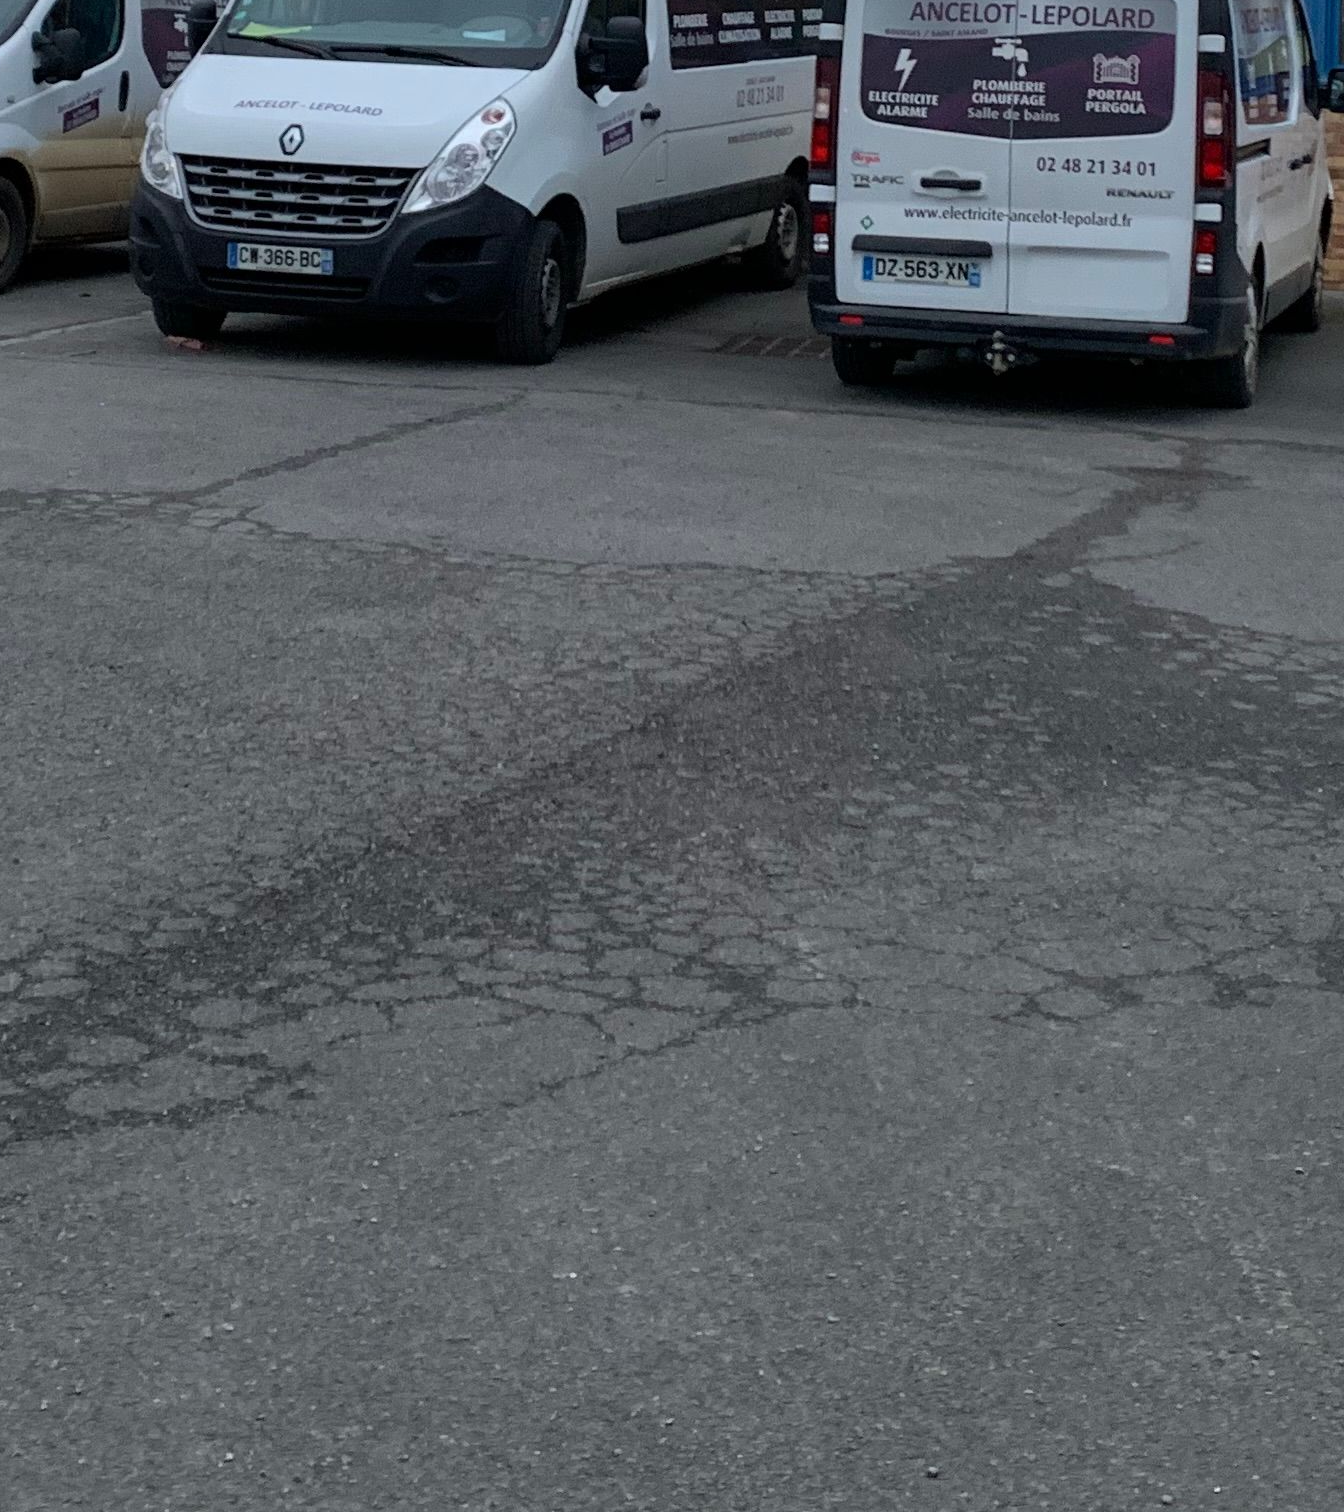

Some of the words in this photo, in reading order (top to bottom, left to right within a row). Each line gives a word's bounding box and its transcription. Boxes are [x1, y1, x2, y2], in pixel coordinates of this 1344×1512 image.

[972, 79, 1046, 94] PLOMBERIE
[868, 90, 939, 106] ELECTRICITE
[971, 92, 1046, 107] CHAUFFAGE
[1087, 87, 1144, 102] PORTAIL
[308, 102, 384, 117] LEPOLARD
[877, 103, 928, 119] ALARME
[967, 106, 1000, 121] Salle
[1002, 107, 1020, 121] de
[1023, 108, 1061, 123] bains
[1085, 100, 1147, 115] PERGOLA
[1036, 156, 1056, 173] 02
[1061, 157, 1082, 174] 48
[1086, 159, 1106, 175] 21
[1111, 160, 1131, 176] 34
[1137, 161, 1157, 177] 01
[851, 172, 905, 186] TRAFIC
[1105, 188, 1176, 200] RENAULT
[904, 206, 1134, 228] www.electricite-ancelot-lepolard.fr
[239, 246, 321, 268] CW-366-BC
[874, 256, 969, 280] DZ-563-XN
